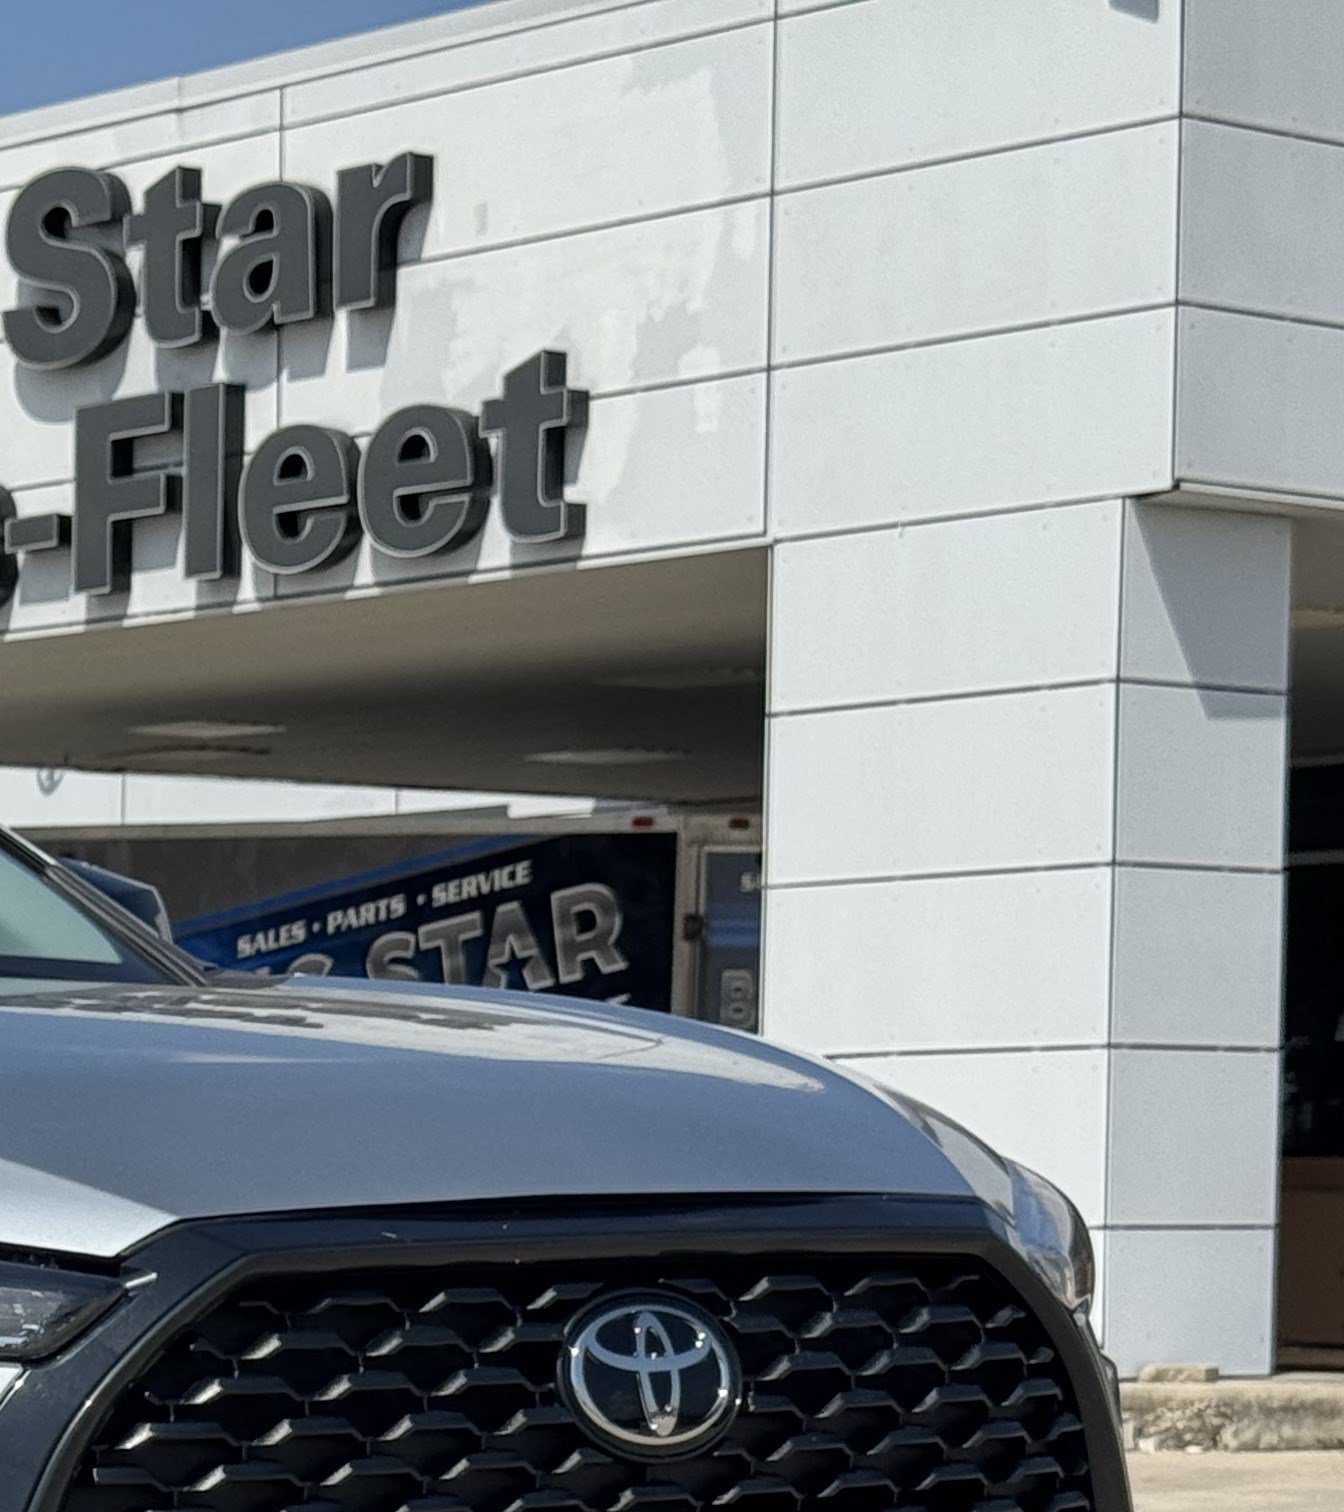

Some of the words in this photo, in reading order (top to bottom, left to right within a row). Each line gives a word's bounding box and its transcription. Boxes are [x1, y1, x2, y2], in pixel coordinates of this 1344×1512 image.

[2, 151, 434, 371] Star
[236, 919, 307, 960] SALES
[326, 894, 406, 935] PARTS
[431, 859, 533, 908] SERVICE
